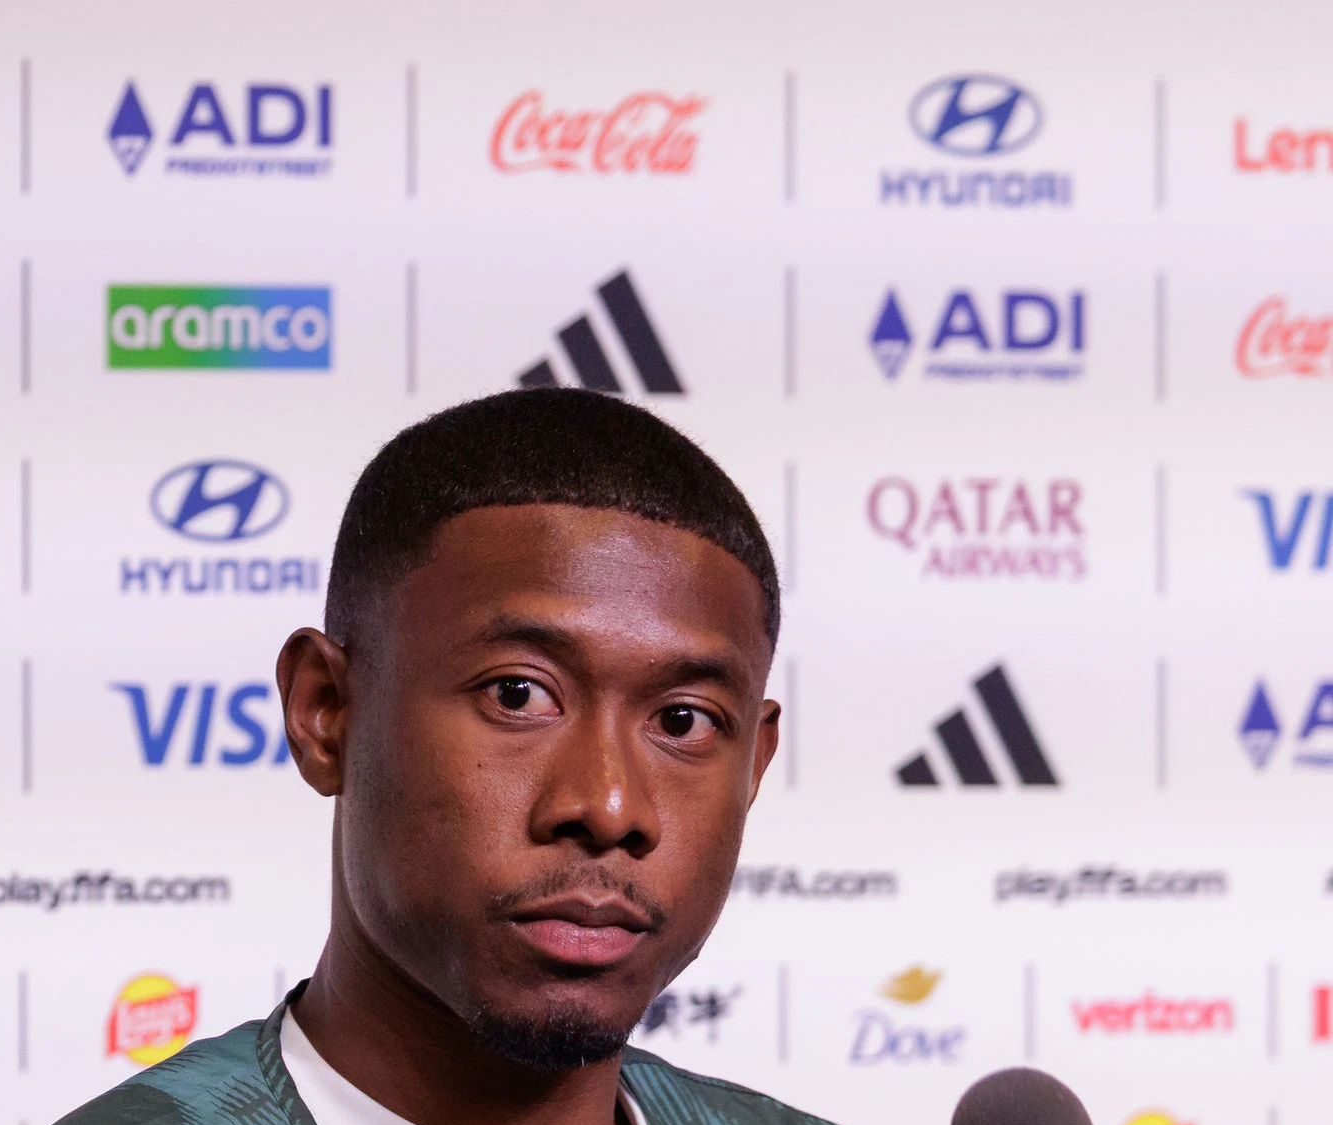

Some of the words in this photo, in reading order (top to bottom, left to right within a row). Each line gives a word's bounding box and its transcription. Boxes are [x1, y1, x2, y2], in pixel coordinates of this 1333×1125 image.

[170, 83, 332, 148] ADI
[488, 89, 706, 175] Coca-Cola
[880, 170, 1072, 209] HYUNDAI
[110, 302, 328, 351] aramco
[929, 290, 1085, 353] ADI
[865, 477, 1085, 549] QATAR
[120, 558, 320, 595] HYUNDAI
[926, 547, 1086, 580] AIRWAYS
[848, 1006, 967, 1065] Dove
[1071, 993, 1234, 1034] verizon
